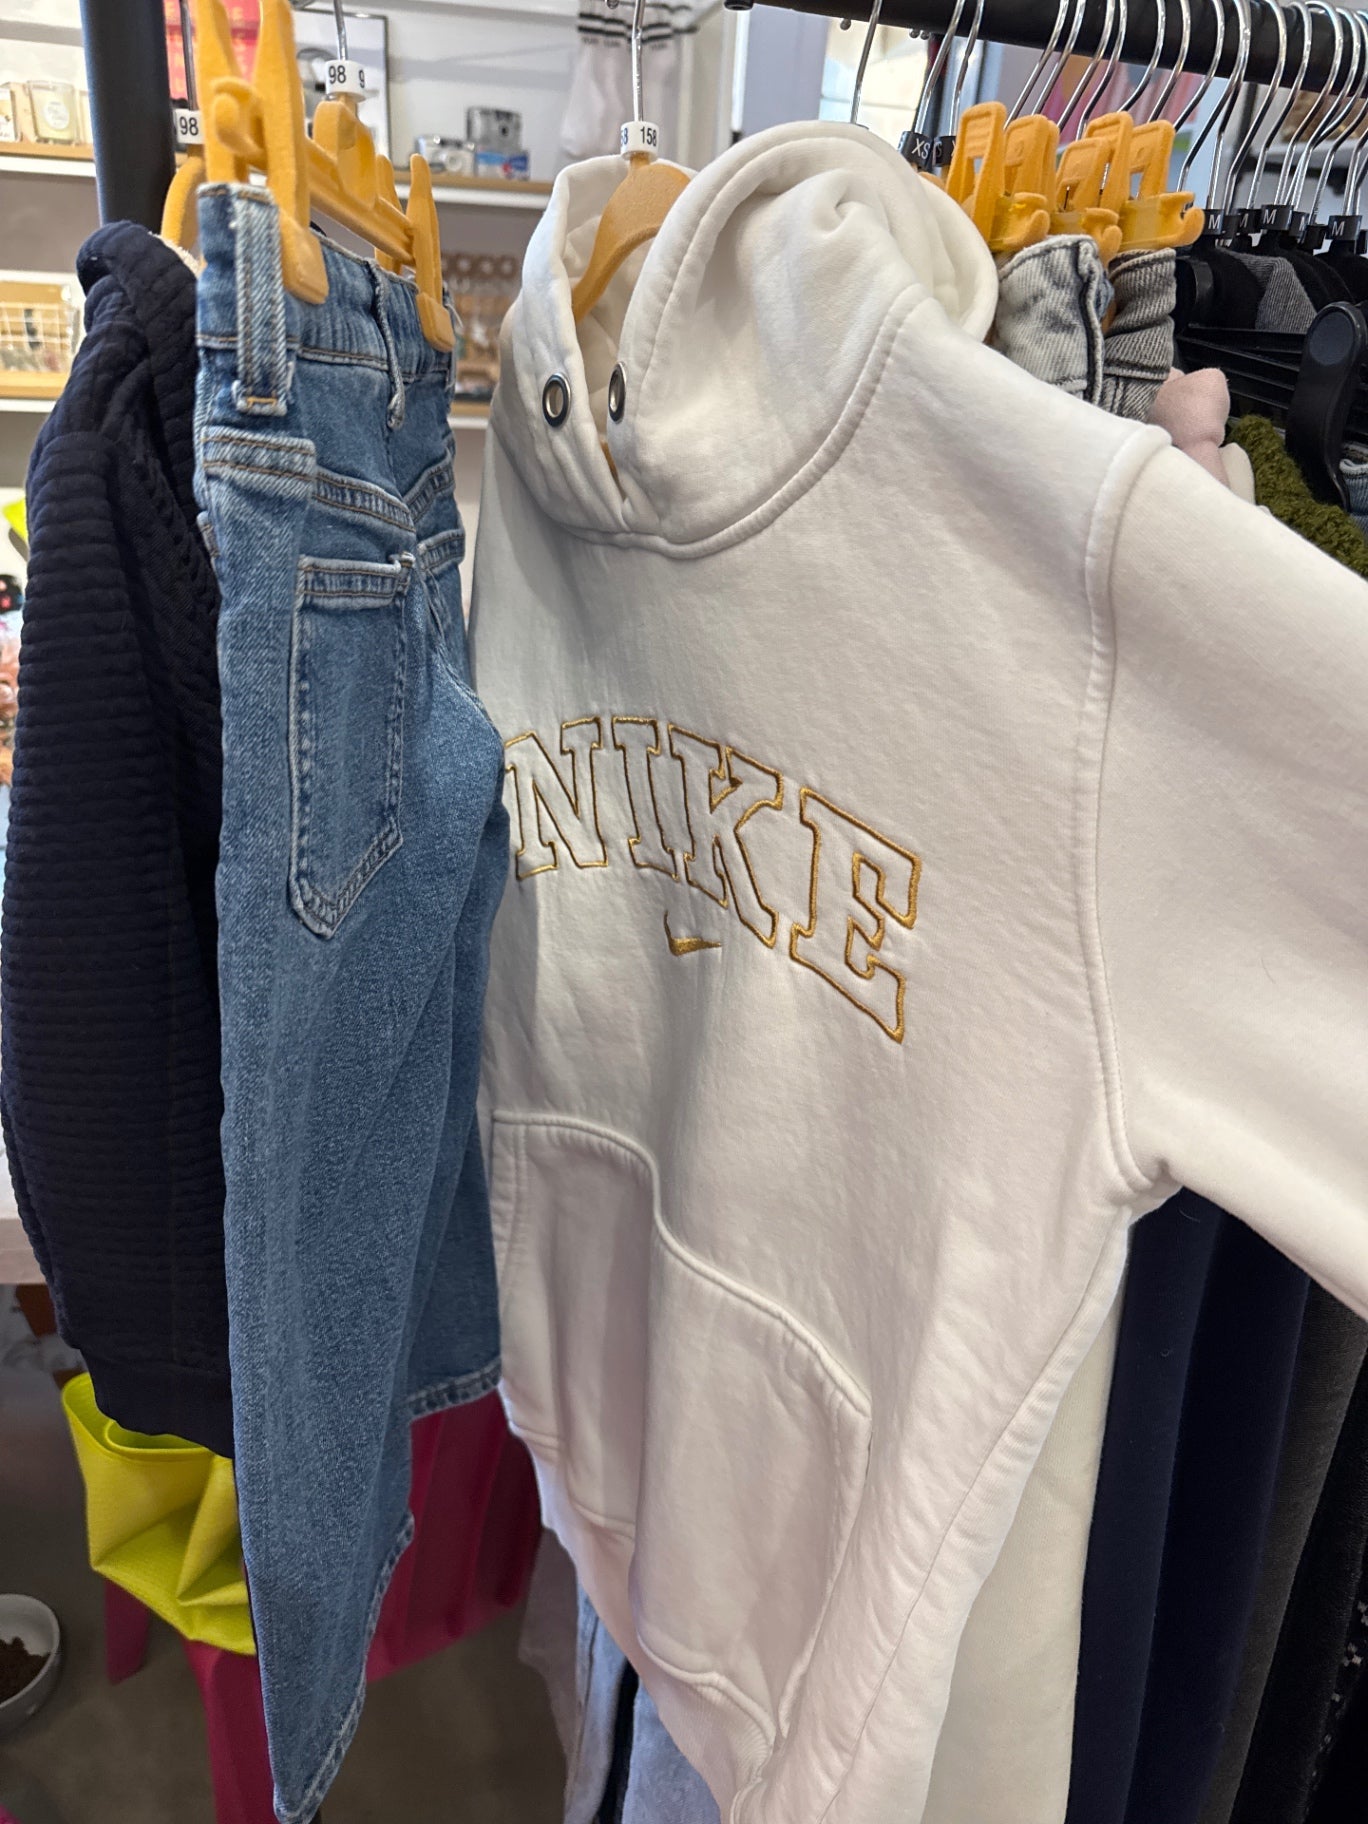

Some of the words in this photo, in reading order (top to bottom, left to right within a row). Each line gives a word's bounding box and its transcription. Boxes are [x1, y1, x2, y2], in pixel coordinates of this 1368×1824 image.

[328, 64, 346, 85] 98
[179, 117, 198, 136] 98
[640, 126, 657, 147] 158
[911, 138, 931, 160] XS
[1207, 214, 1221, 230] M
[1239, 213, 1249, 228] M
[1262, 209, 1277, 225] M
[1331, 220, 1345, 237] M
[504, 716, 922, 1044] NIKE
